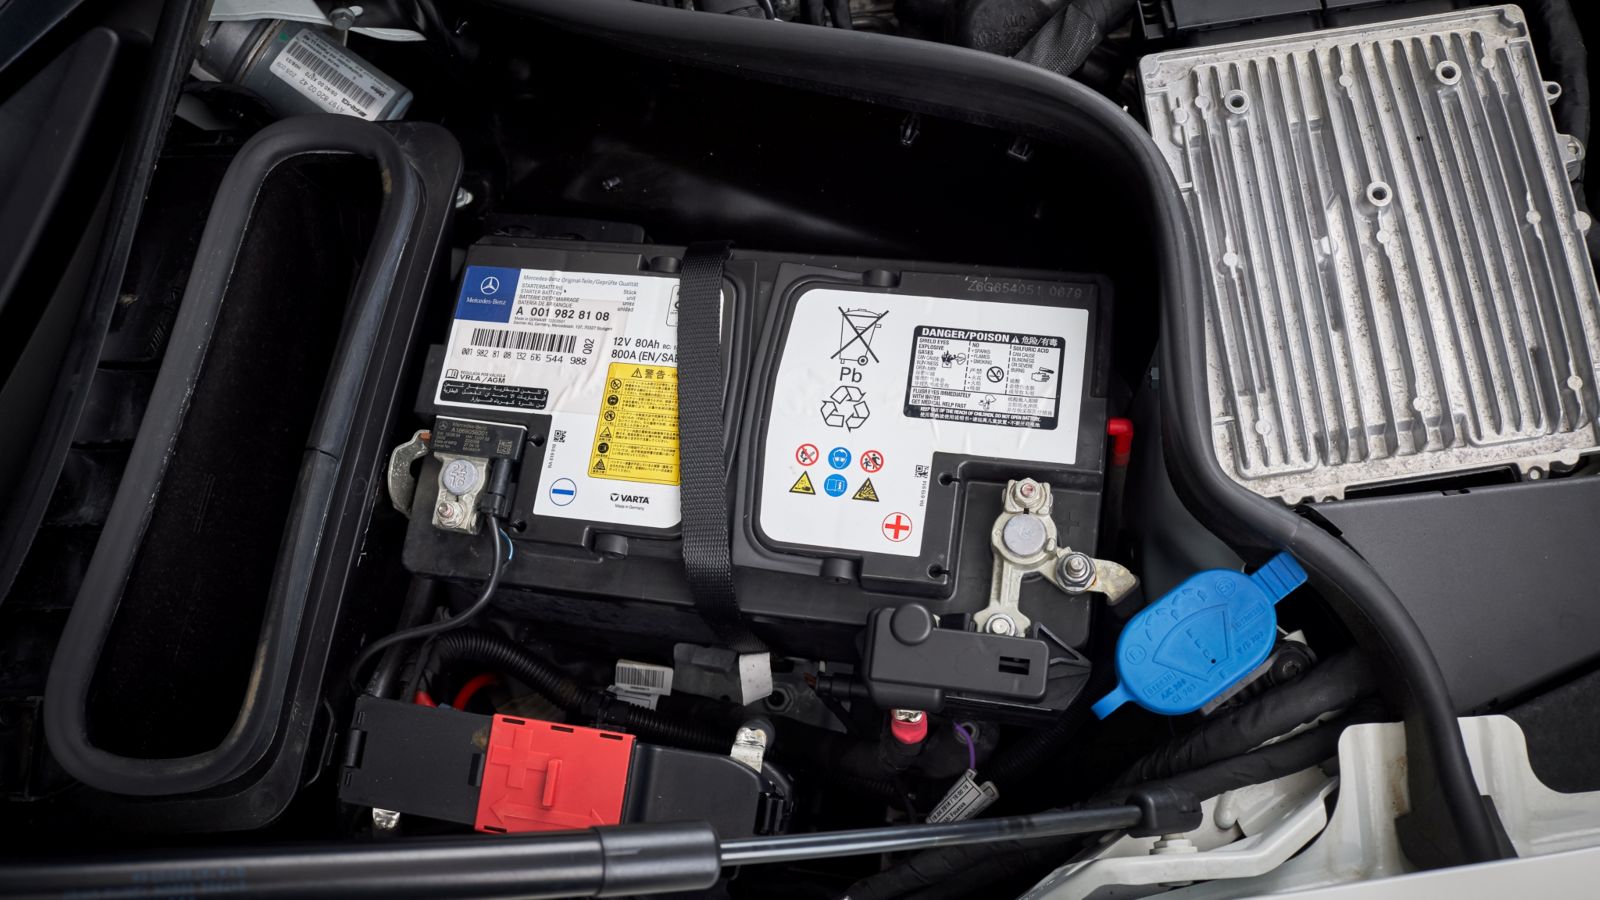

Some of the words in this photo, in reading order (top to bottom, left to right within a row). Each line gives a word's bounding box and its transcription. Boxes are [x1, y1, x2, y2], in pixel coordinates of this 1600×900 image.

[299, 78, 309, 87] 42
[307, 84, 318, 94] 02
[315, 91, 329, 103] 820
[523, 275, 560, 283] Mercedes-Benz
[466, 296, 506, 305] Mercedes-Benz
[516, 306, 523, 315] A
[530, 307, 550, 317] 001
[554, 309, 575, 319] 982
[578, 310, 591, 320] 81
[595, 311, 610, 321] 08
[921, 328, 1010, 343] DANGER/POISON
[583, 338, 595, 354] Q02
[613, 336, 631, 347] 12V
[635, 338, 660, 349] 80Ah
[461, 347, 472, 356] 001
[477, 349, 488, 357] 982
[492, 350, 500, 358] 81
[503, 351, 512, 359] 08
[546, 354, 564, 363] 544
[570, 356, 587, 365] 988
[611, 349, 636, 360] 800A
[839, 366, 862, 383] Pb
[621, 494, 650, 504] VARTA
